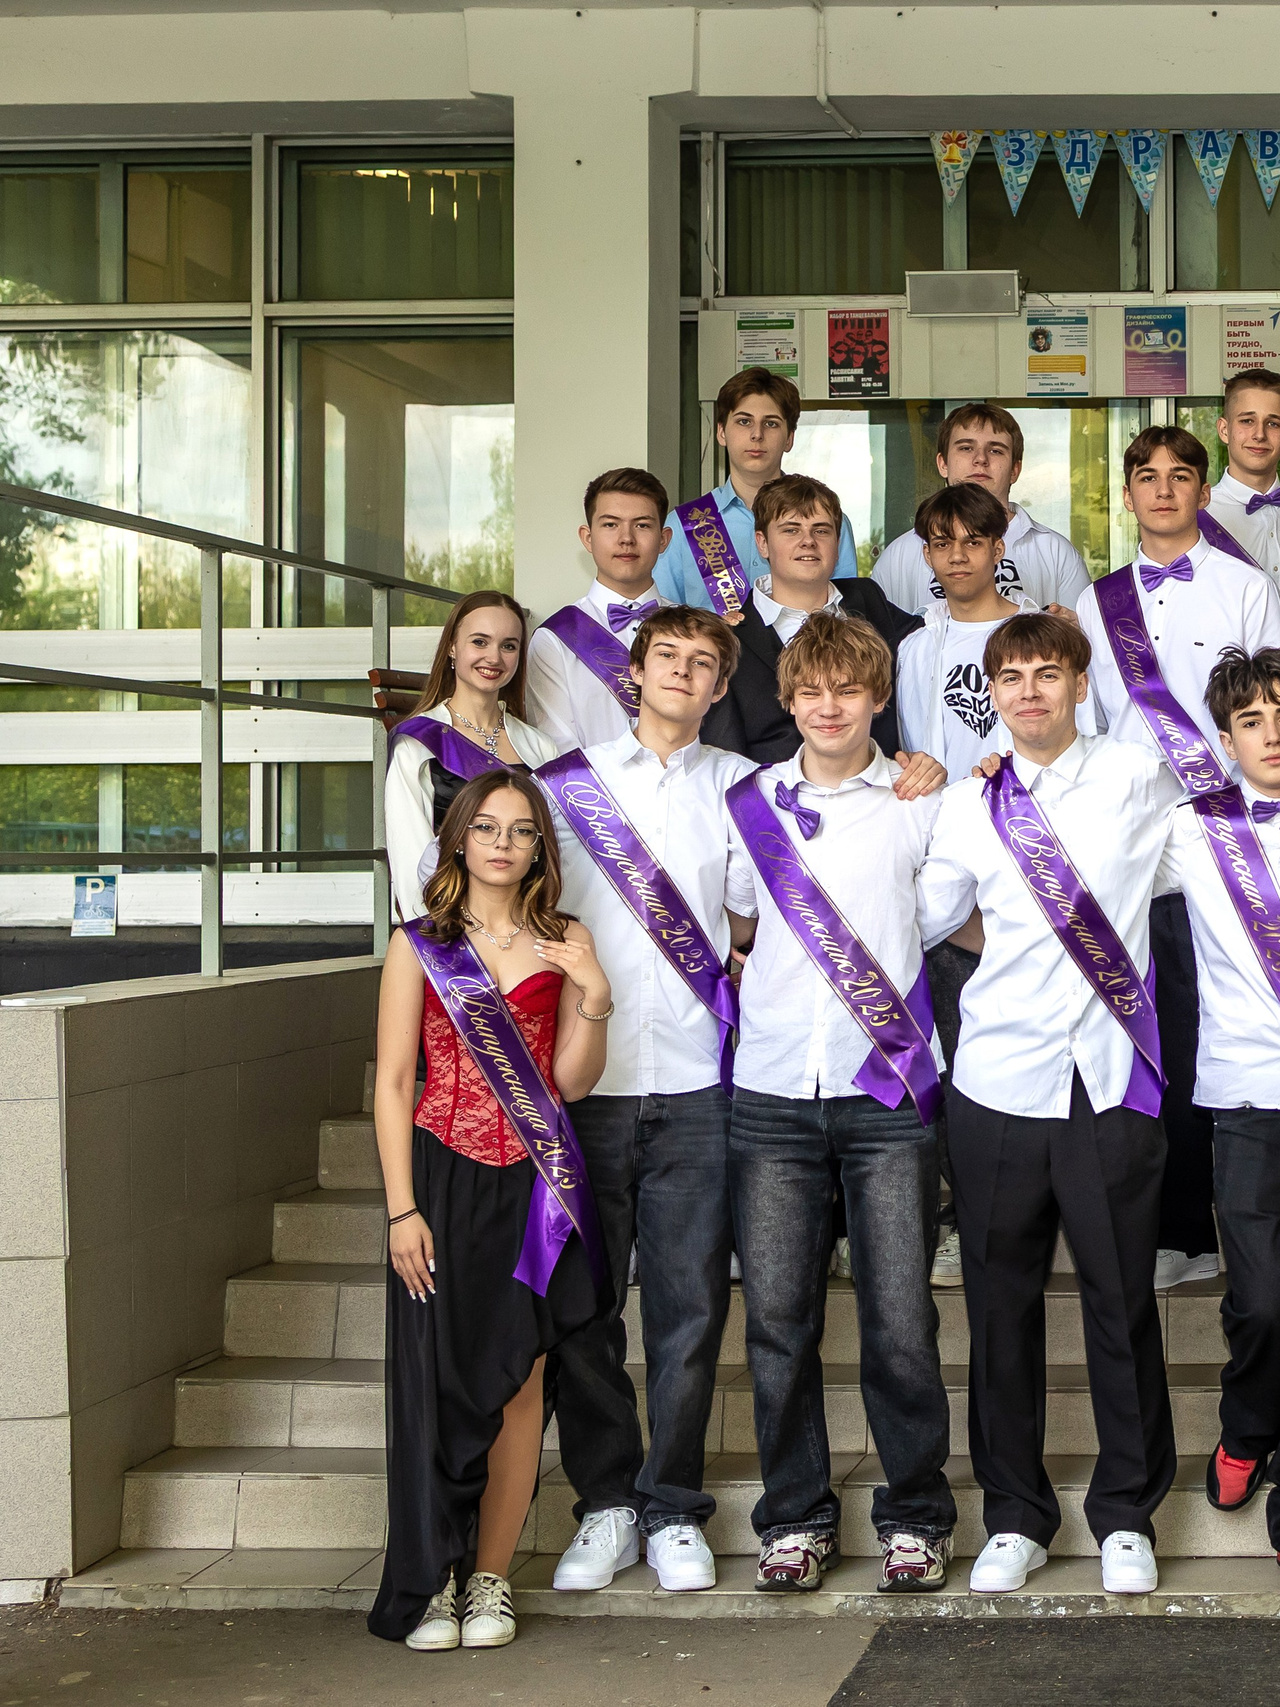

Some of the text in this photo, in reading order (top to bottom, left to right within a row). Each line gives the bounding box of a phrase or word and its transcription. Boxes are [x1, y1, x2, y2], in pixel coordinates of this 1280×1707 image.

[834, 318, 882, 330] ГРУППУ
[1226, 361, 1265, 369] ТРУДНЕЕ
[944, 664, 990, 695] 20
[1113, 617, 1224, 792] Выпускник 2025
[86, 877, 105, 902] P
[560, 781, 674, 923] Выпускник
[658, 921, 710, 974] 2025
[1006, 816, 1144, 1016] Выпускник 2025
[757, 831, 901, 1028] Выпускник 2025
[445, 975, 584, 1190] Выпускница 2025
[775, 1572, 788, 1581] 43
